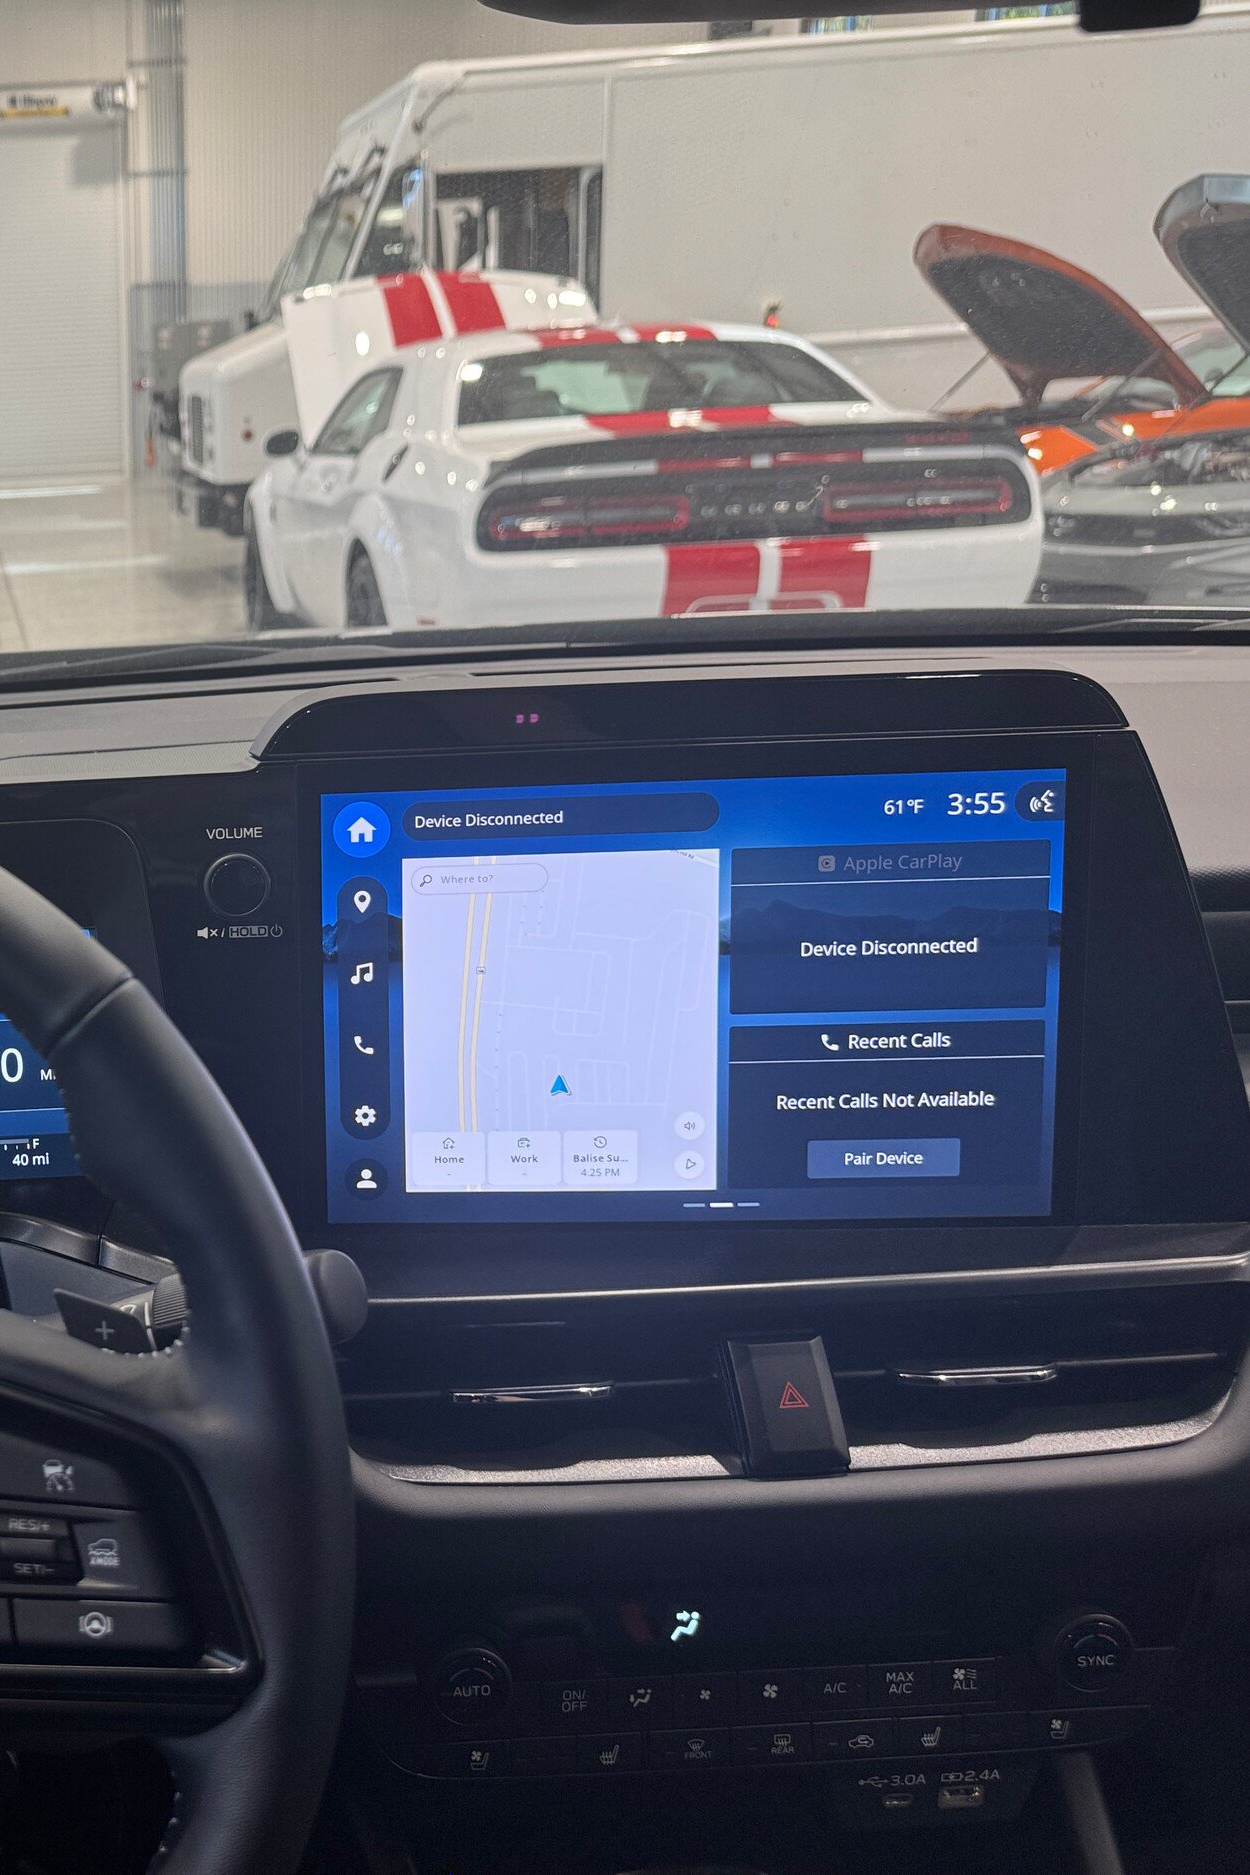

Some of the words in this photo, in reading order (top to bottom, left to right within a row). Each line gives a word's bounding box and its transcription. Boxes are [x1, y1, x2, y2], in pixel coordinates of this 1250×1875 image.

[883, 799, 924, 815] 61°F
[947, 792, 1006, 816] 3:55
[414, 815, 461, 829] Device
[465, 810, 564, 827] Disconnected
[206, 826, 263, 840] VOLUME
[843, 854, 893, 873] Apple
[898, 853, 963, 872] CarPlay
[440, 875, 475, 884] Where
[477, 874, 494, 884] to?
[230, 926, 268, 938] HOLD
[800, 940, 857, 957] Device
[861, 937, 979, 956] Disconnected
[847, 1034, 907, 1050] Recent
[910, 1031, 951, 1048] Calls
[0, 1047, 24, 1083] 0
[775, 1094, 835, 1111] Recent
[838, 1093, 879, 1109] Calls
[882, 1092, 915, 1108] Not
[917, 1091, 995, 1108] Available
[32, 1138, 40, 1149] F
[12, 1153, 29, 1166] 40
[32, 1152, 50, 1165] mi
[434, 1155, 465, 1164] Home
[510, 1154, 539, 1164] Work
[573, 1153, 604, 1163] Balise
[844, 1151, 873, 1165] Pair
[875, 1150, 923, 1165] Device
[580, 1168, 602, 1177] 4:25
[604, 1168, 620, 1177] PM
[1077, 1654, 1115, 1667] SYNC
[886, 1671, 915, 1683] MAX
[453, 1684, 491, 1698] AUTO
[823, 1682, 846, 1694] A/C
[888, 1682, 913, 1694] A/C
[953, 1680, 977, 1690] ALL
[562, 1689, 586, 1701] ON/
[561, 1700, 588, 1712] OFF
[684, 1750, 712, 1760] FRONT
[770, 1747, 795, 1755] REAR
[890, 1773, 926, 1786] 3.0A
[963, 1769, 1000, 1782] 2.4A
